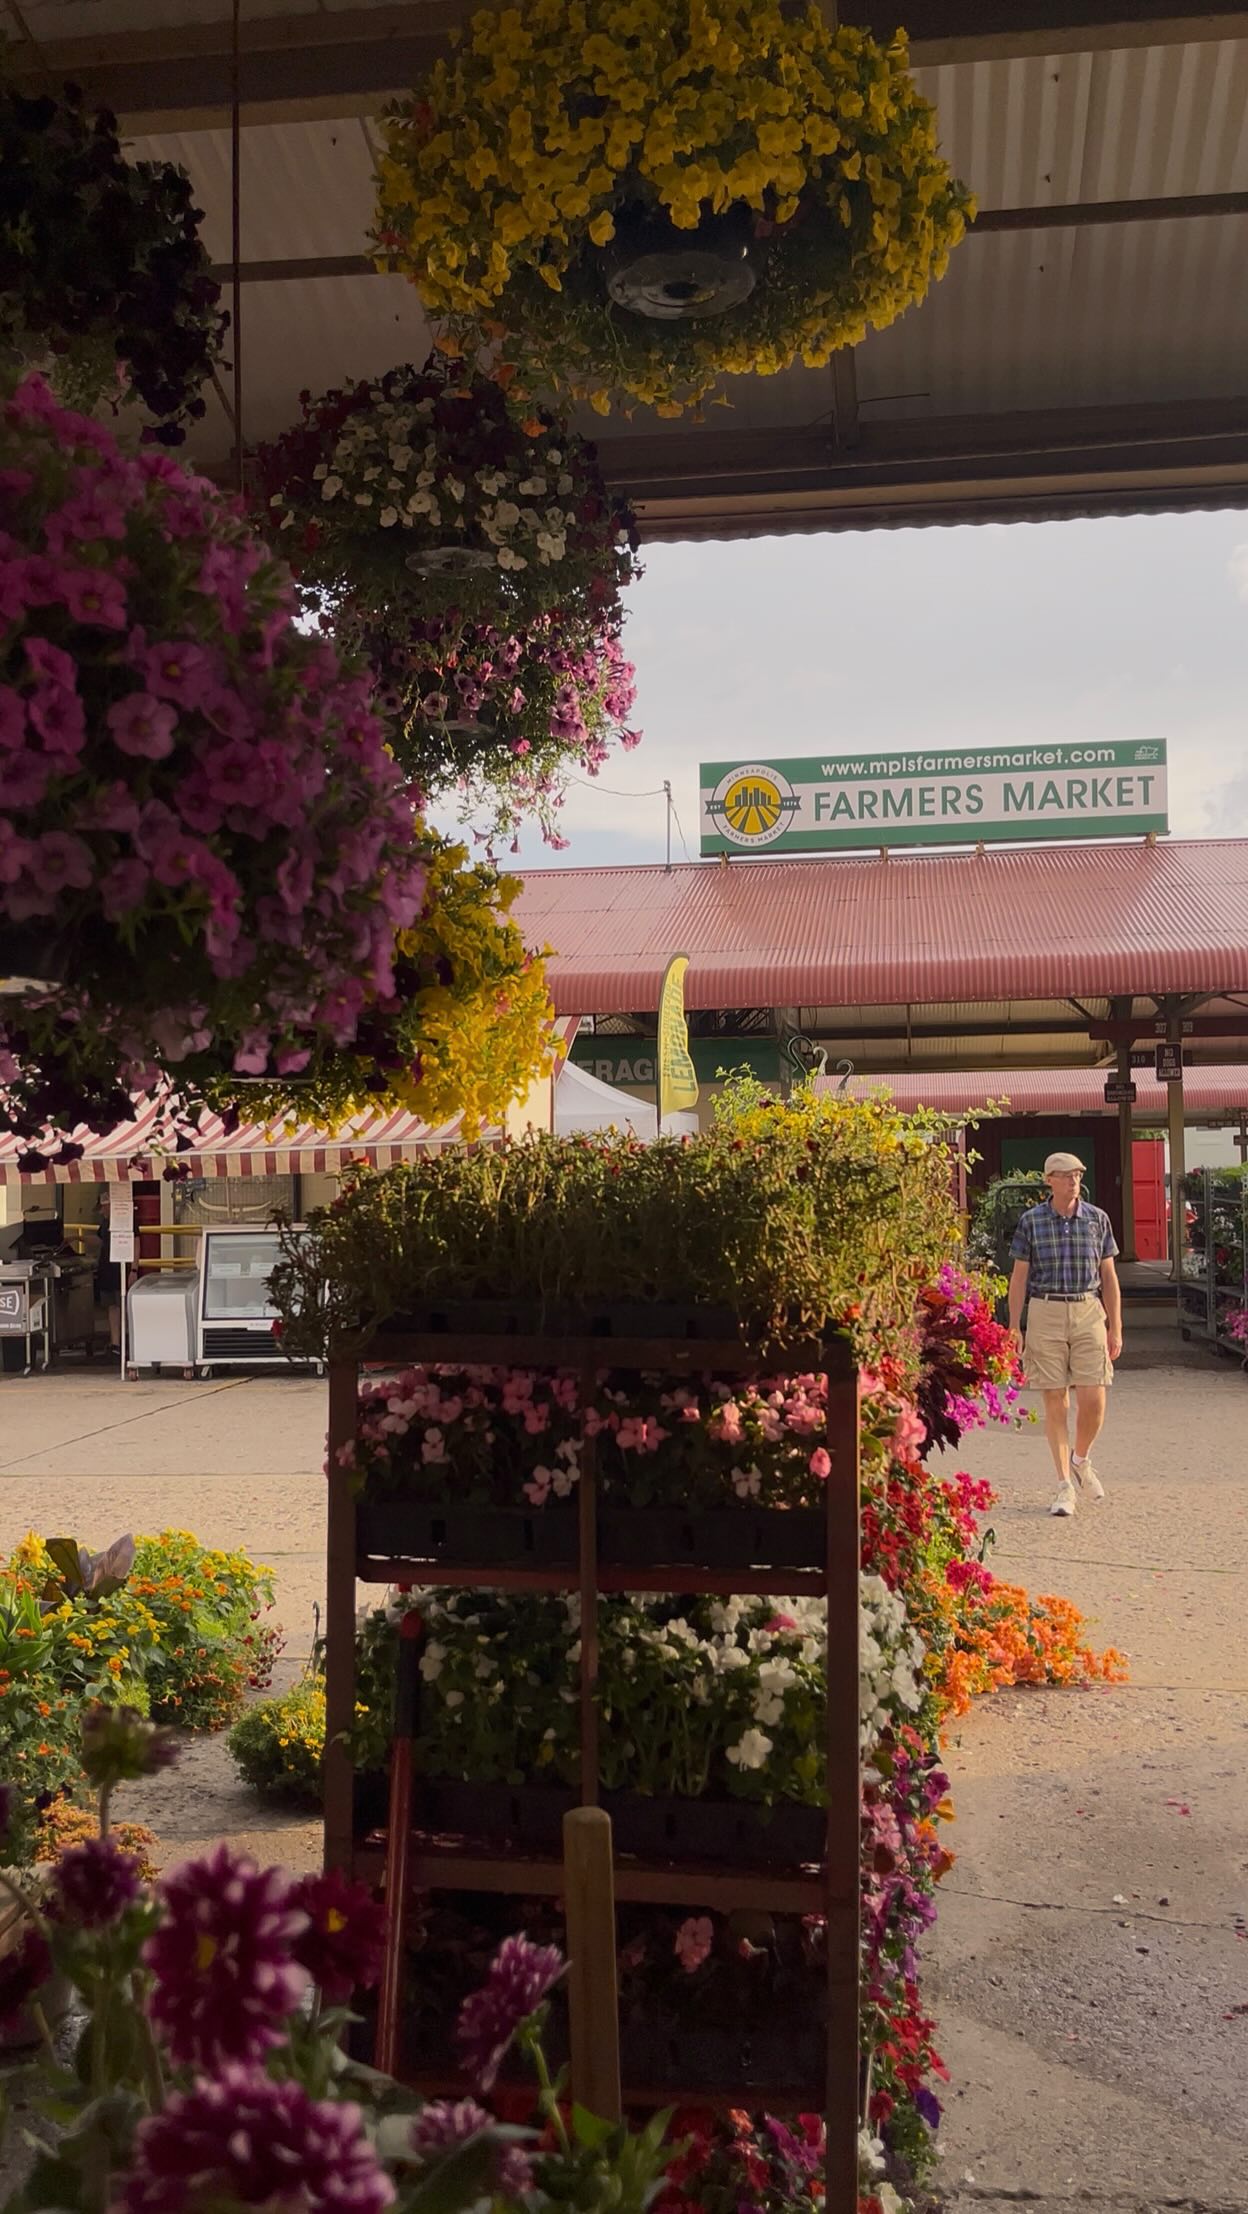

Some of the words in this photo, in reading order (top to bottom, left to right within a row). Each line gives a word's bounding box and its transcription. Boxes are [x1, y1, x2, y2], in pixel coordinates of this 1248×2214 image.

[821, 747, 1116, 776] www.mplsfarmersmarket.com
[726, 768, 778, 784] MINNEAPOLIS
[814, 783, 984, 822] FARMERS
[1002, 775, 1155, 813] MARKET
[722, 823, 755, 844] FARMERS
[756, 821, 785, 842] MARKET
[669, 973, 696, 1092] LEMONADE
[1164, 1047, 1174, 1057] NO
